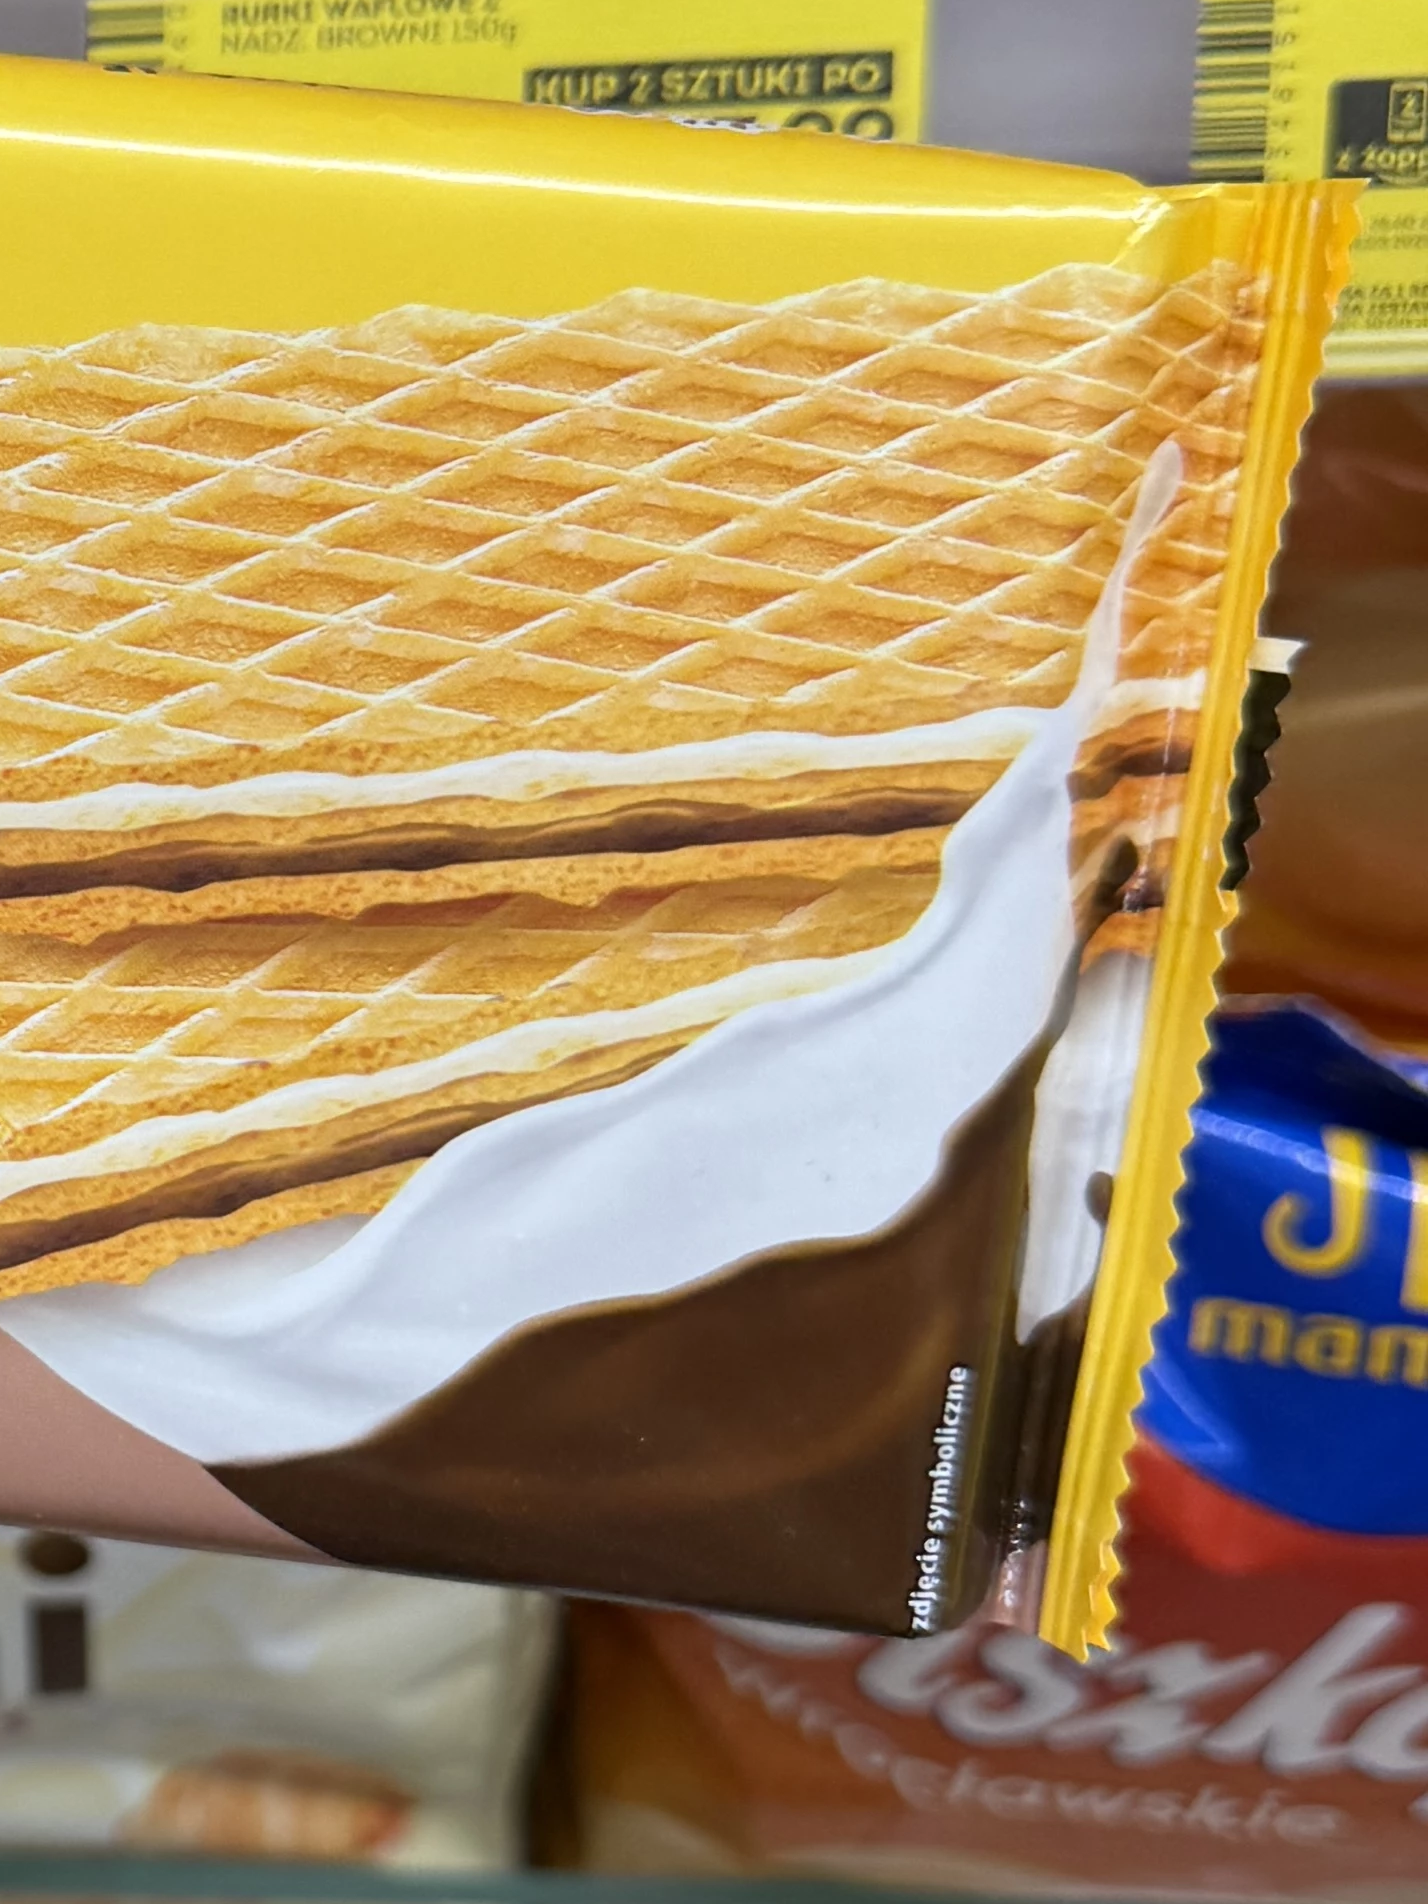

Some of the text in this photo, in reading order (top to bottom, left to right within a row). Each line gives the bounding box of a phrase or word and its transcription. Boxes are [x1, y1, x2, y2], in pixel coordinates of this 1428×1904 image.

[663, 64, 811, 100] SZTUKI
[824, 57, 881, 92] PO
[907, 1364, 969, 1634] zdjęcie symboliczne
